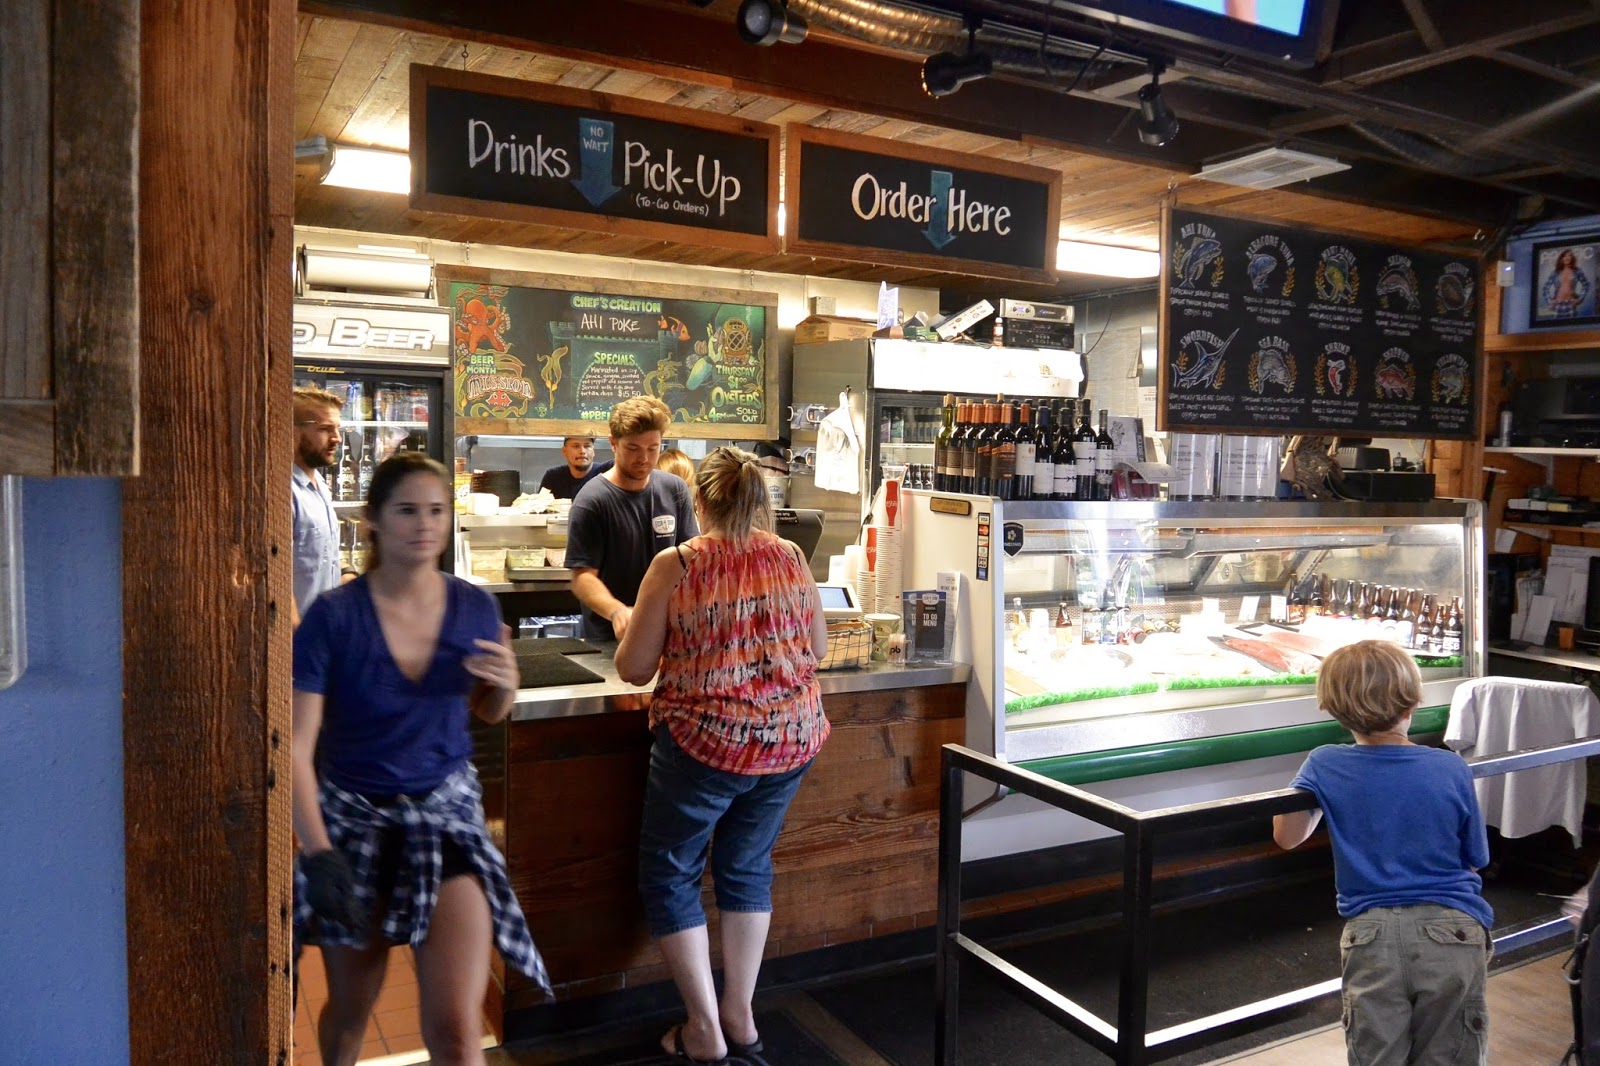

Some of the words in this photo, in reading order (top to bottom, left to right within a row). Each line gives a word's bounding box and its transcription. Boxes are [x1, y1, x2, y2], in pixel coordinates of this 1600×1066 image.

[590, 126, 604, 138] NO
[468, 118, 571, 178] Drinks
[583, 137, 609, 153] WAIT
[624, 140, 741, 217] Pick-Up
[672, 199, 710, 217] Orders)
[851, 172, 937, 223] Order
[947, 187, 1012, 236] Here
[572, 295, 608, 310] CHEF'S
[609, 298, 661, 313] CREATION
[581, 313, 603, 331] AHI
[609, 317, 640, 333] POKE
[1180, 329, 1225, 349] SWORDFISH
[470, 355, 495, 365] BEER
[593, 351, 636, 367] SPECIALS
[466, 366, 497, 375] MONTH
[715, 364, 756, 377] THURSDAY
[711, 386, 762, 410] OYSTERS
[736, 406, 758, 415] SOLD
[889, 645, 901, 655] pb
